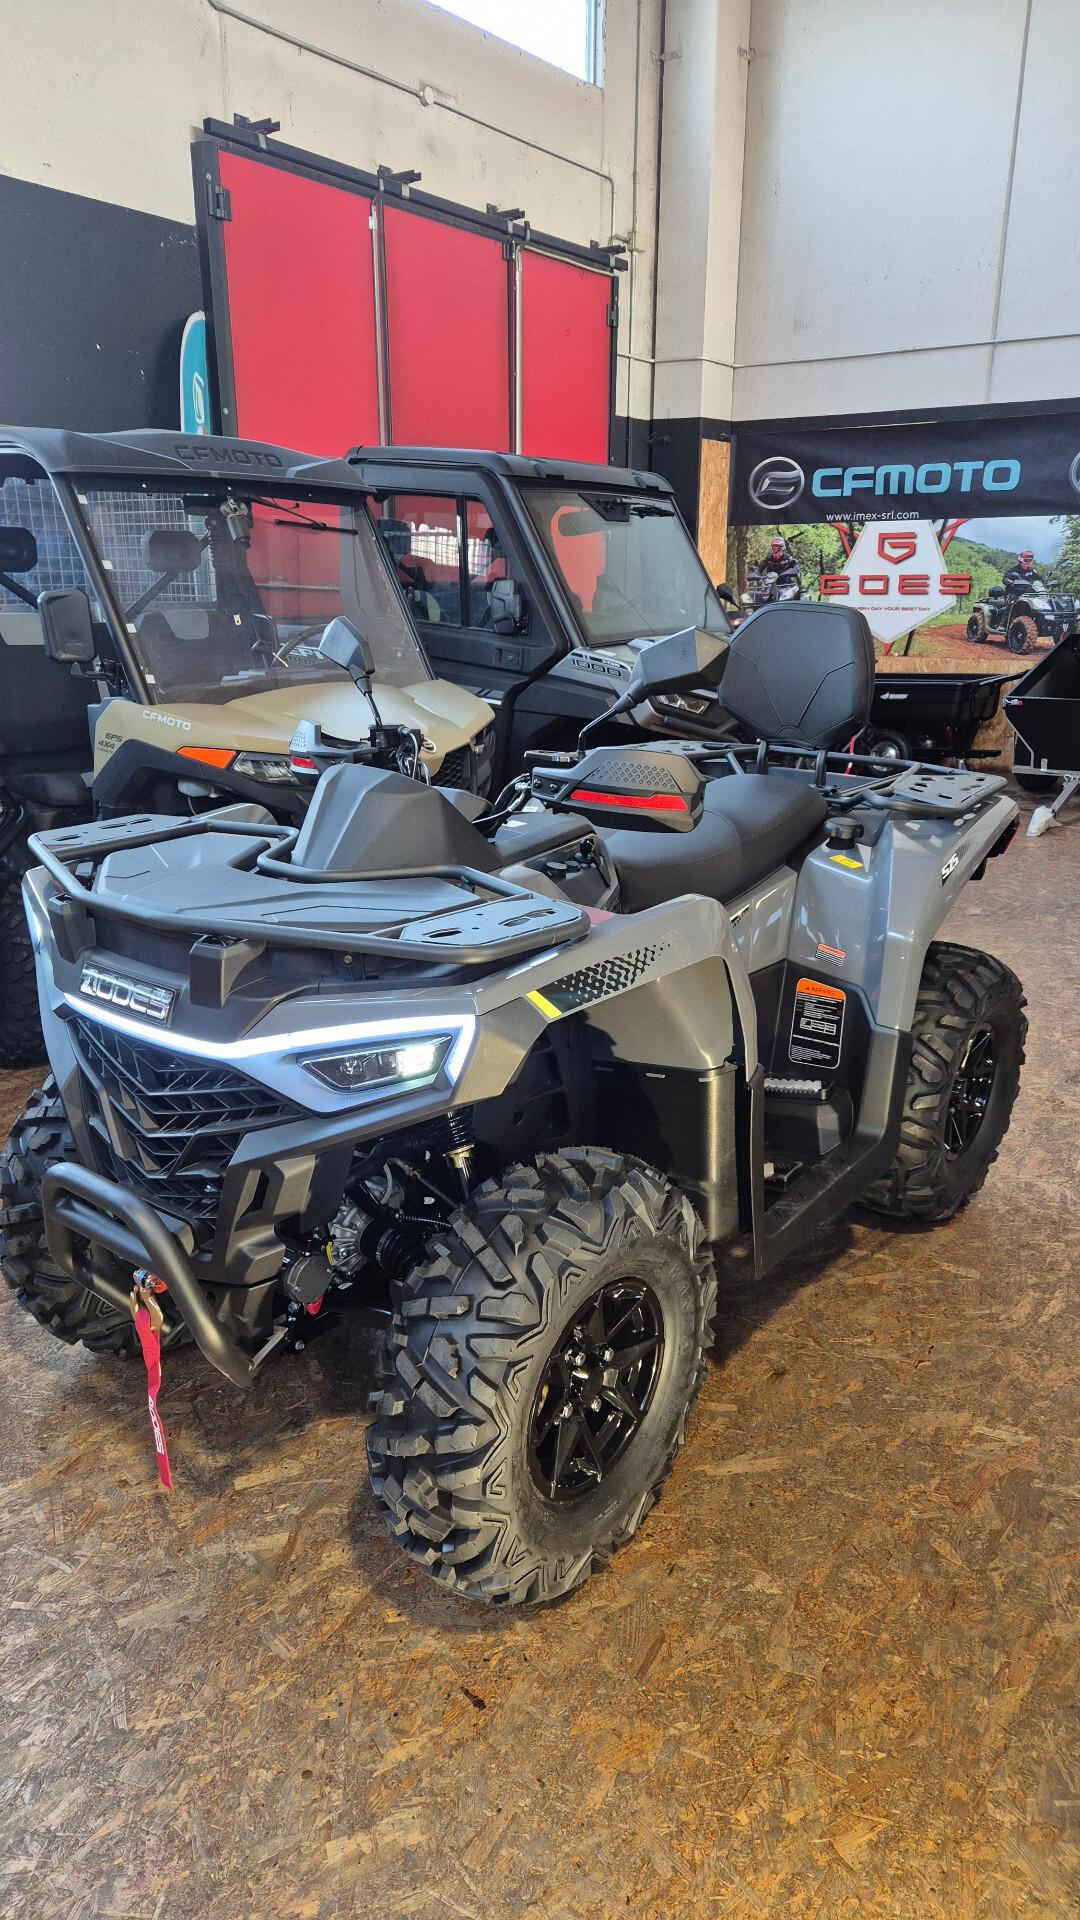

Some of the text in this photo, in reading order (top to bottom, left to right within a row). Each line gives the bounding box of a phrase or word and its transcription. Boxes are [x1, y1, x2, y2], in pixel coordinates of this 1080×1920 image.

[174, 445, 283, 468] CFMOTO
[812, 459, 1021, 497] CFMOTO
[826, 510, 920, 521] www.imex-srl.com
[818, 574, 971, 595] GOES
[142, 709, 192, 731] CFMOTO
[105, 732, 124, 742] EPS
